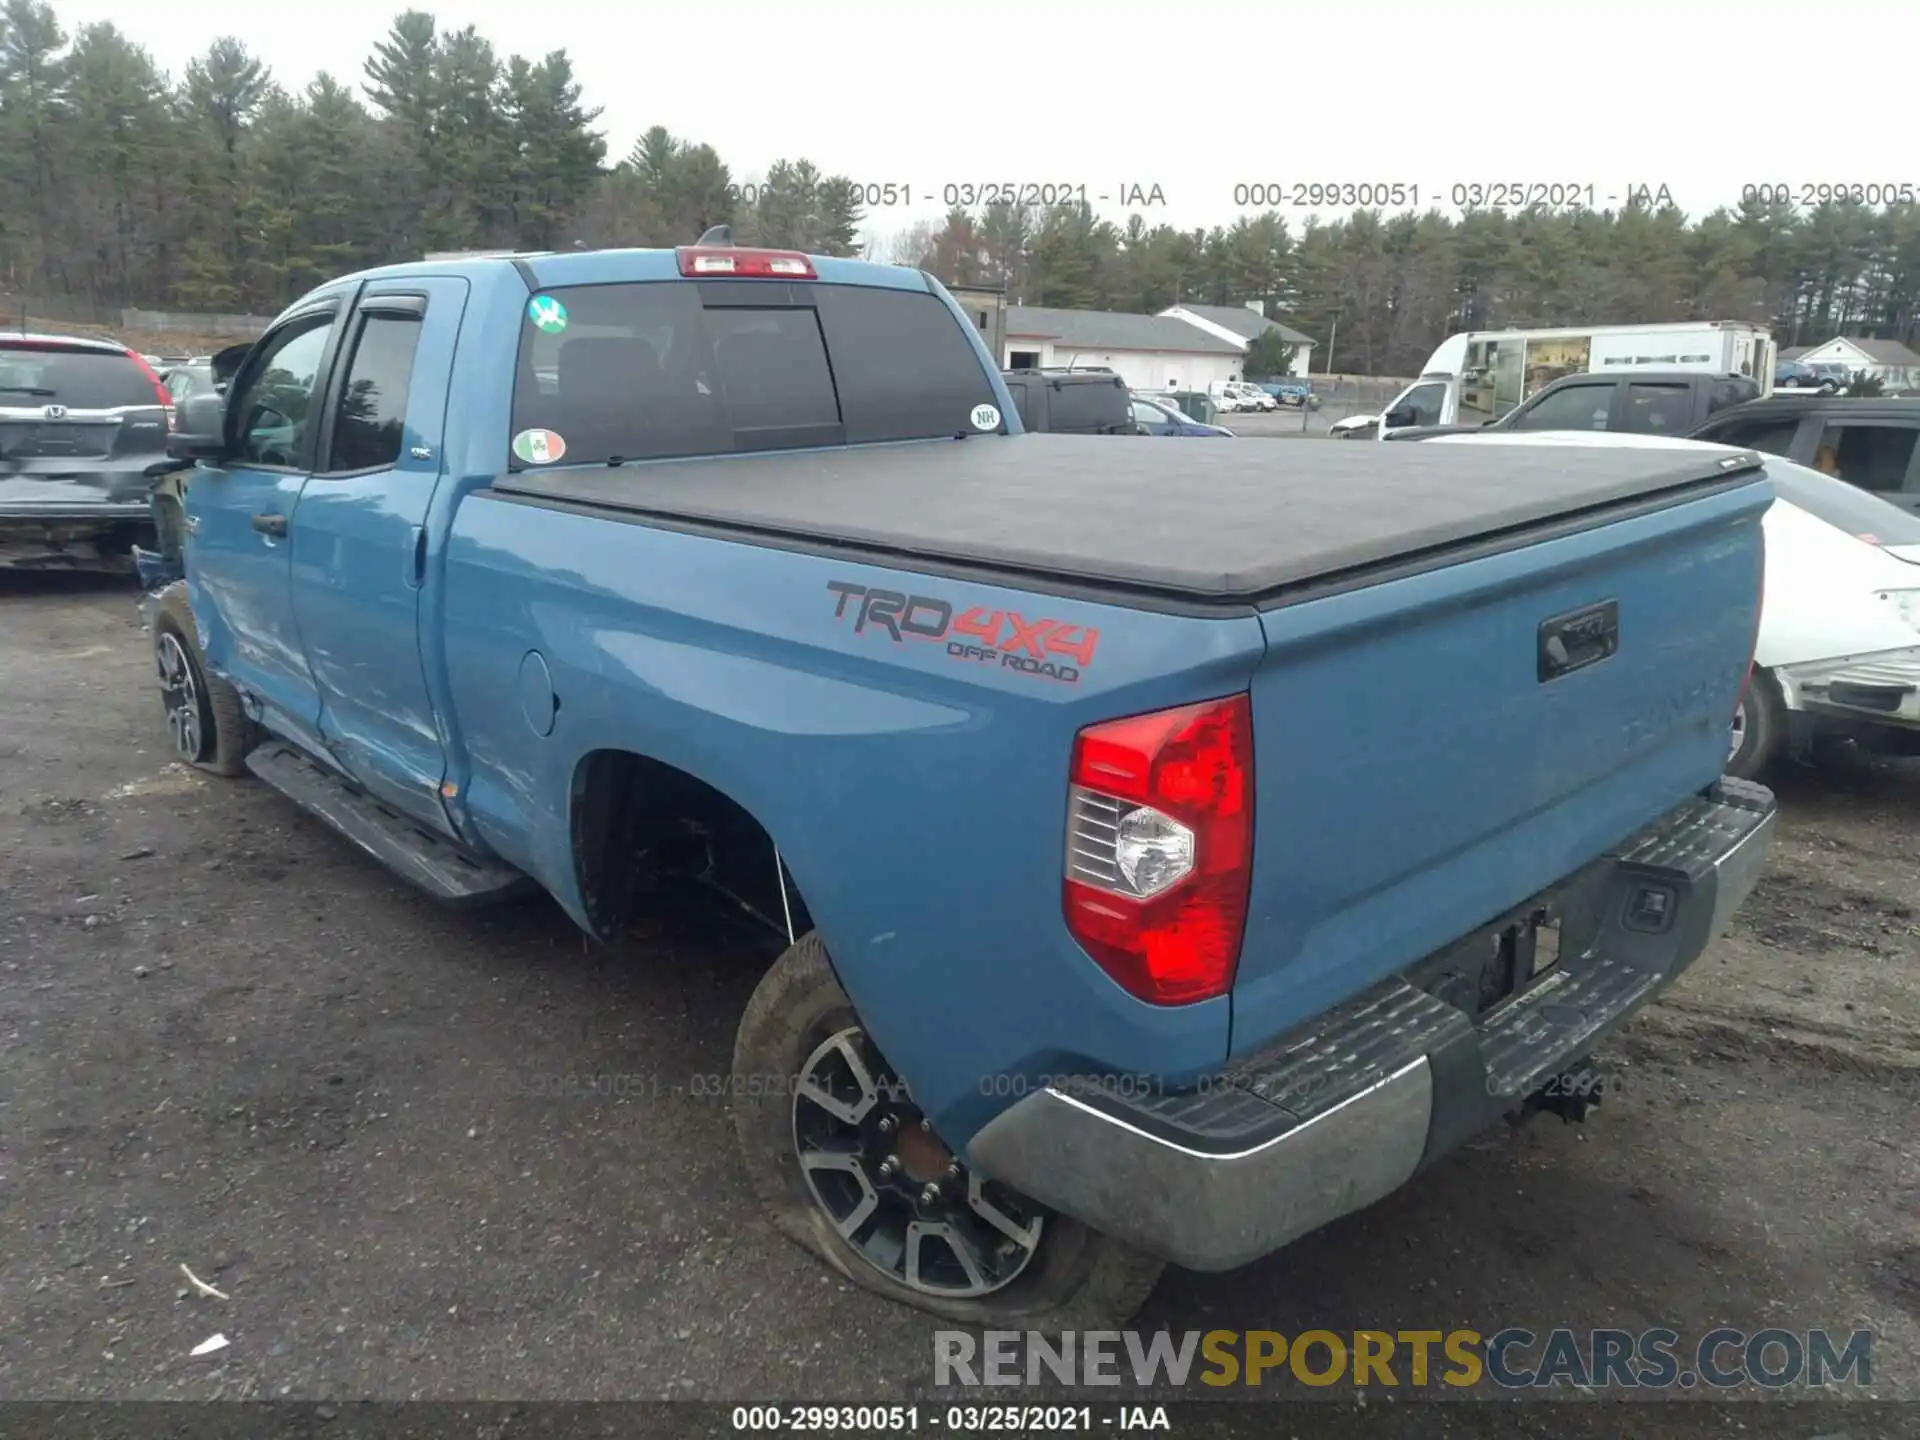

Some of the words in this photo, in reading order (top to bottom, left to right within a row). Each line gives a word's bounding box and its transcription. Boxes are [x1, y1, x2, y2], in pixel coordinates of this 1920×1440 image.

[976, 410, 995, 425] NH
[826, 580, 952, 643] TRD
[946, 641, 998, 662] OFF
[1001, 655, 1079, 683] ROAD
